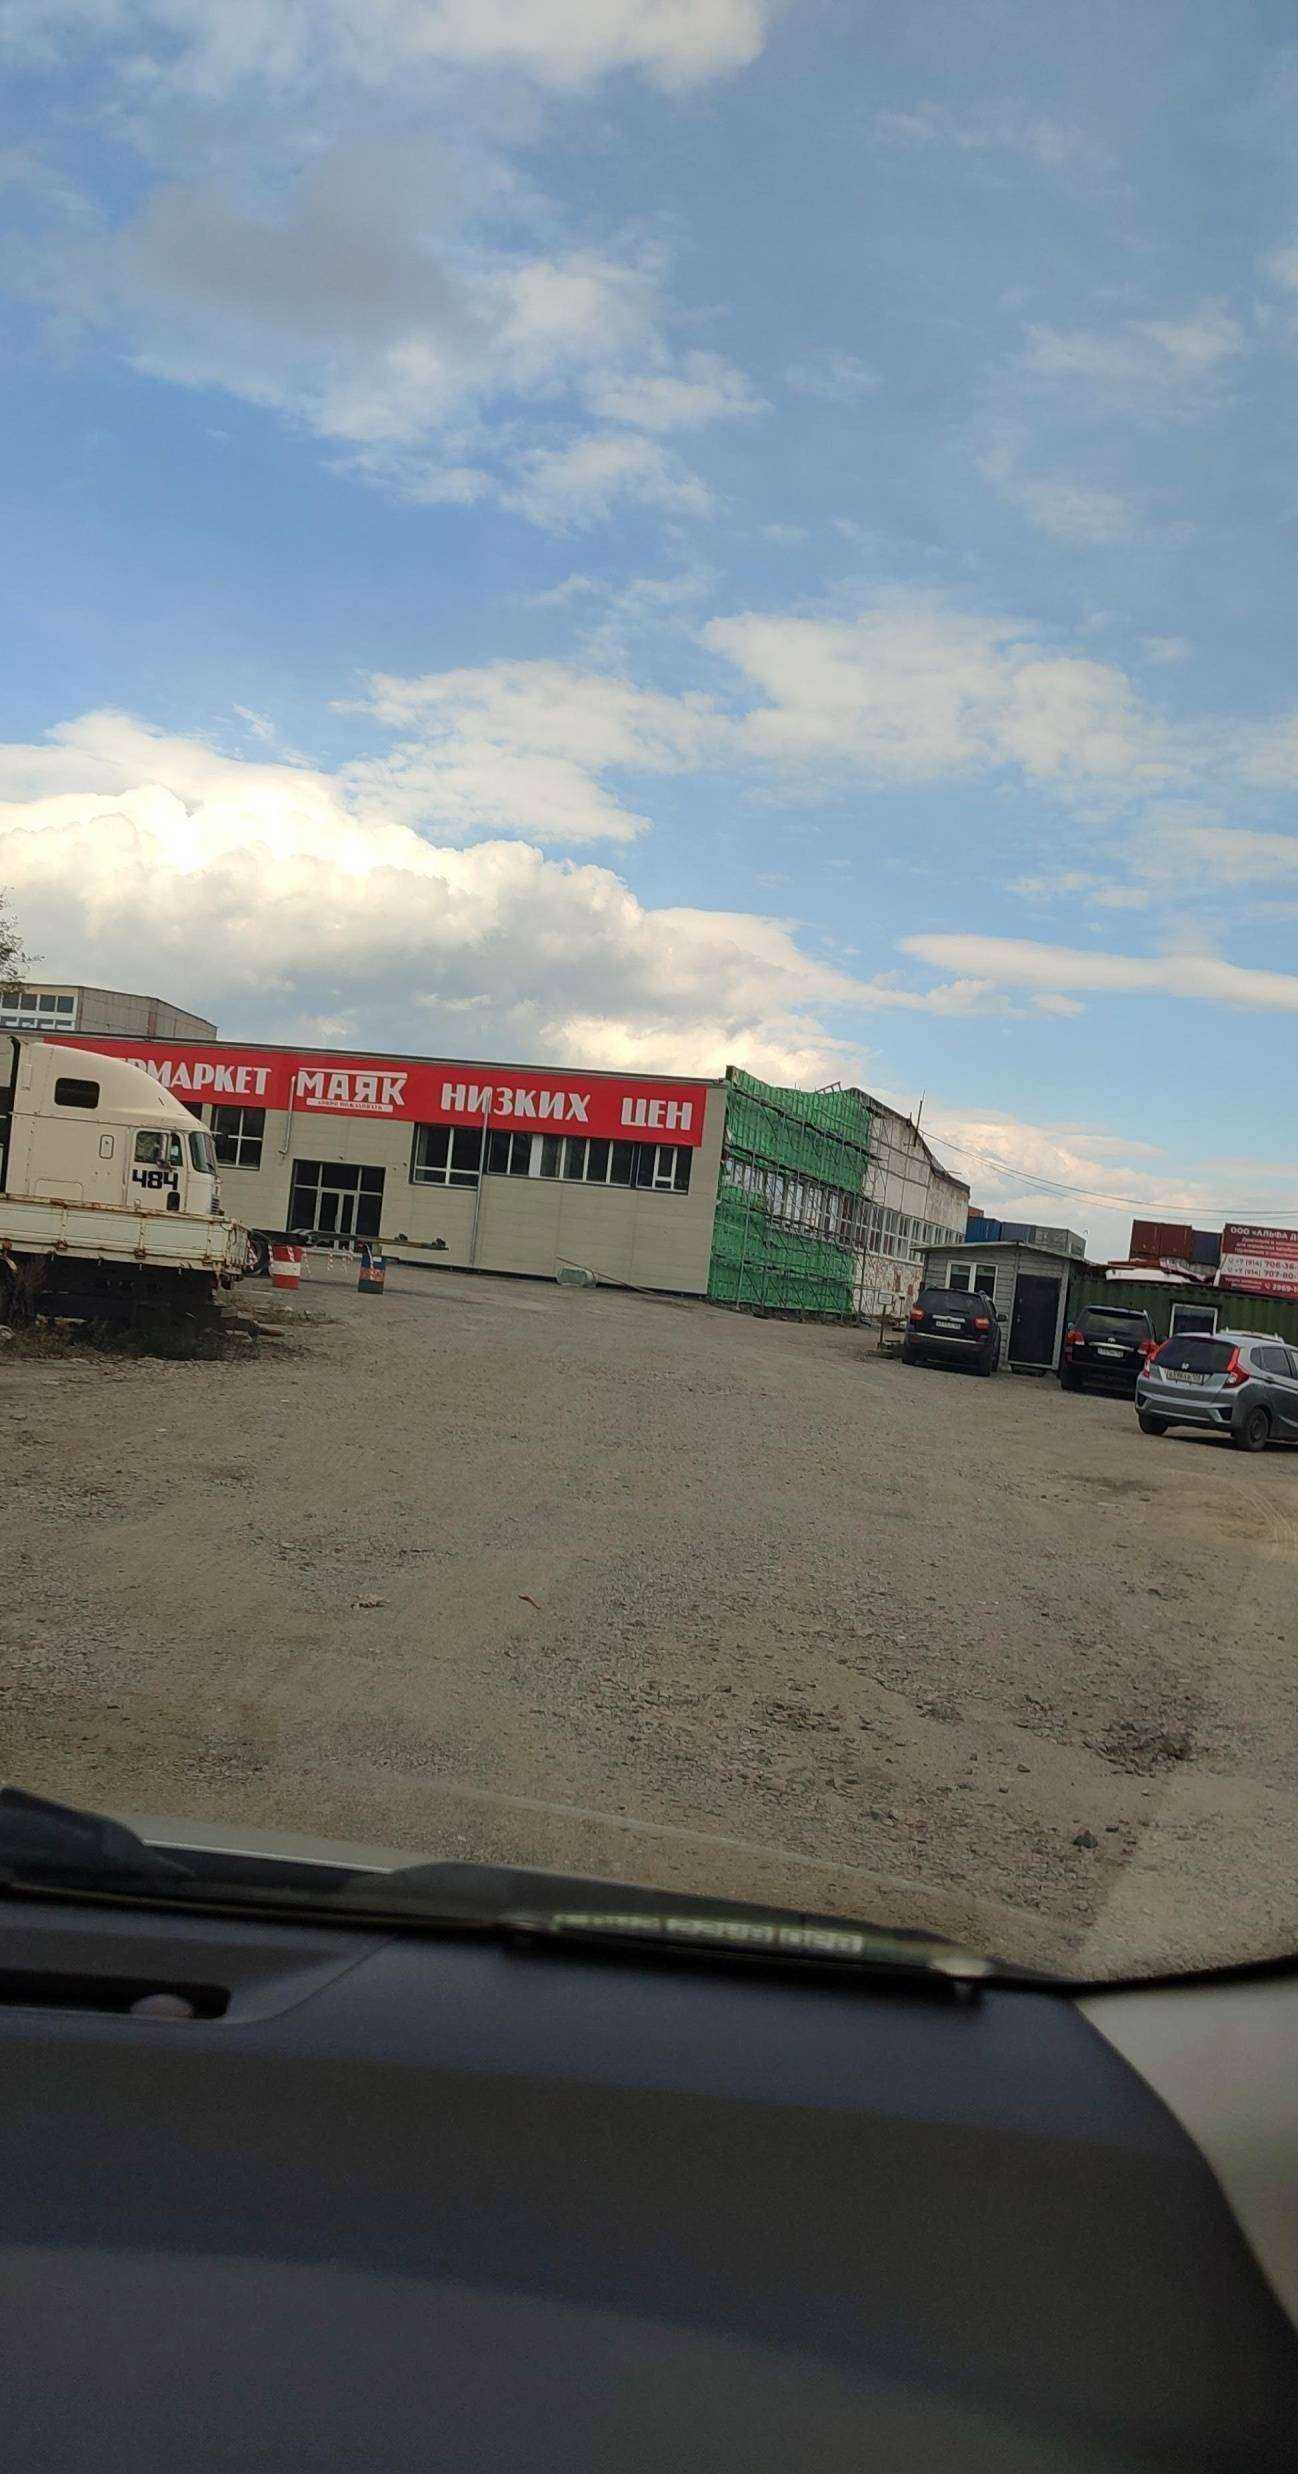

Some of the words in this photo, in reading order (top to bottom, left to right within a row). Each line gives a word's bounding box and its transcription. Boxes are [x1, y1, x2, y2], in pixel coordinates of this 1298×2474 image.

[117, 1057, 272, 1095] МАРКЕТ
[296, 1071, 407, 1106] МАЯК
[440, 1083, 591, 1123] НИЗКИХ
[620, 1097, 693, 1131] ЦЕН
[132, 1168, 179, 1191] 484
[1230, 1226, 1250, 1235] ООО
